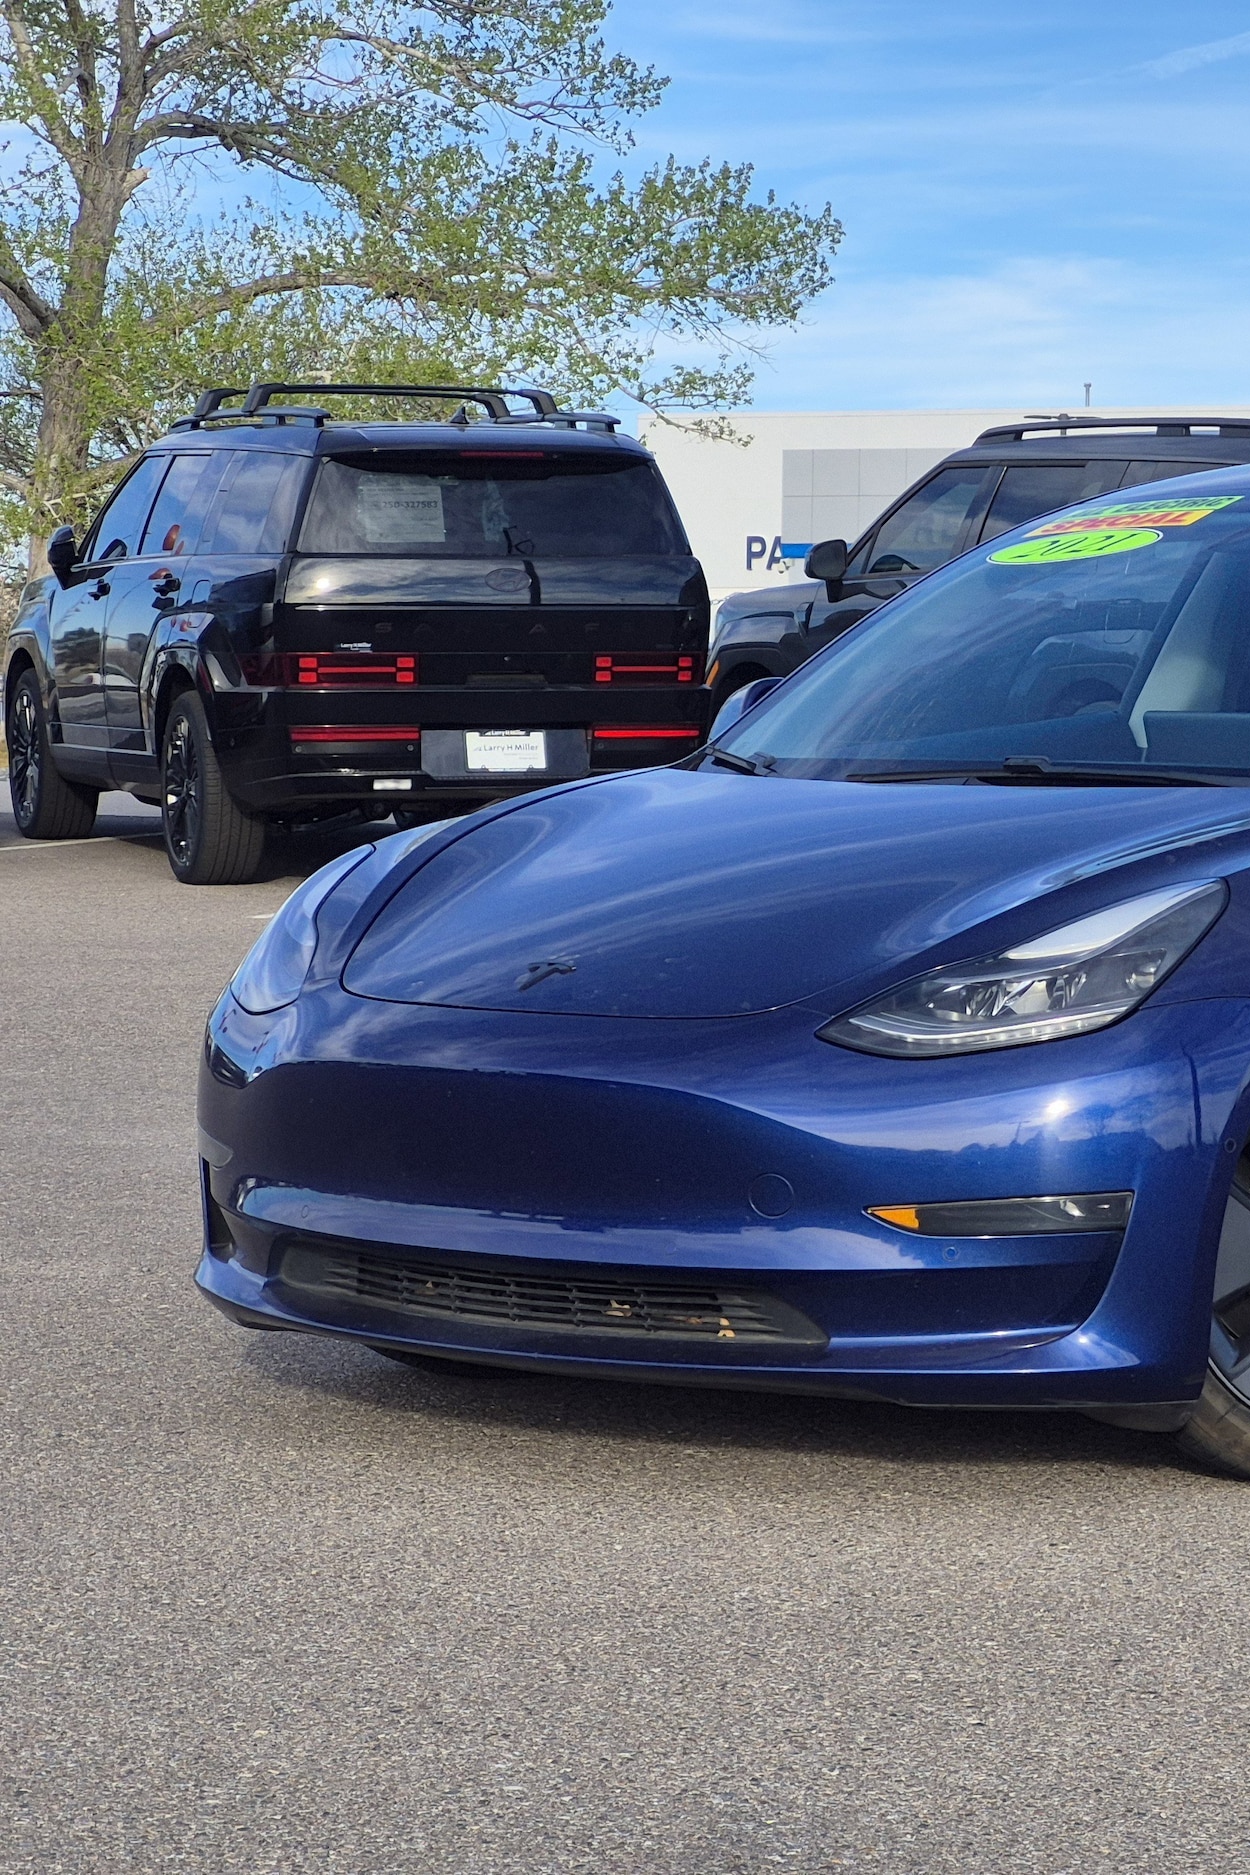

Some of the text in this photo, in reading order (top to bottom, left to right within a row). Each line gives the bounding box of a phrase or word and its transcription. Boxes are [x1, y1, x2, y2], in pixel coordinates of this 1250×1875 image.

[1041, 511, 1193, 533] SPECIAL
[1007, 533, 1143, 559] 2021
[483, 743, 505, 752] Larry
[514, 742, 539, 751] Miller
